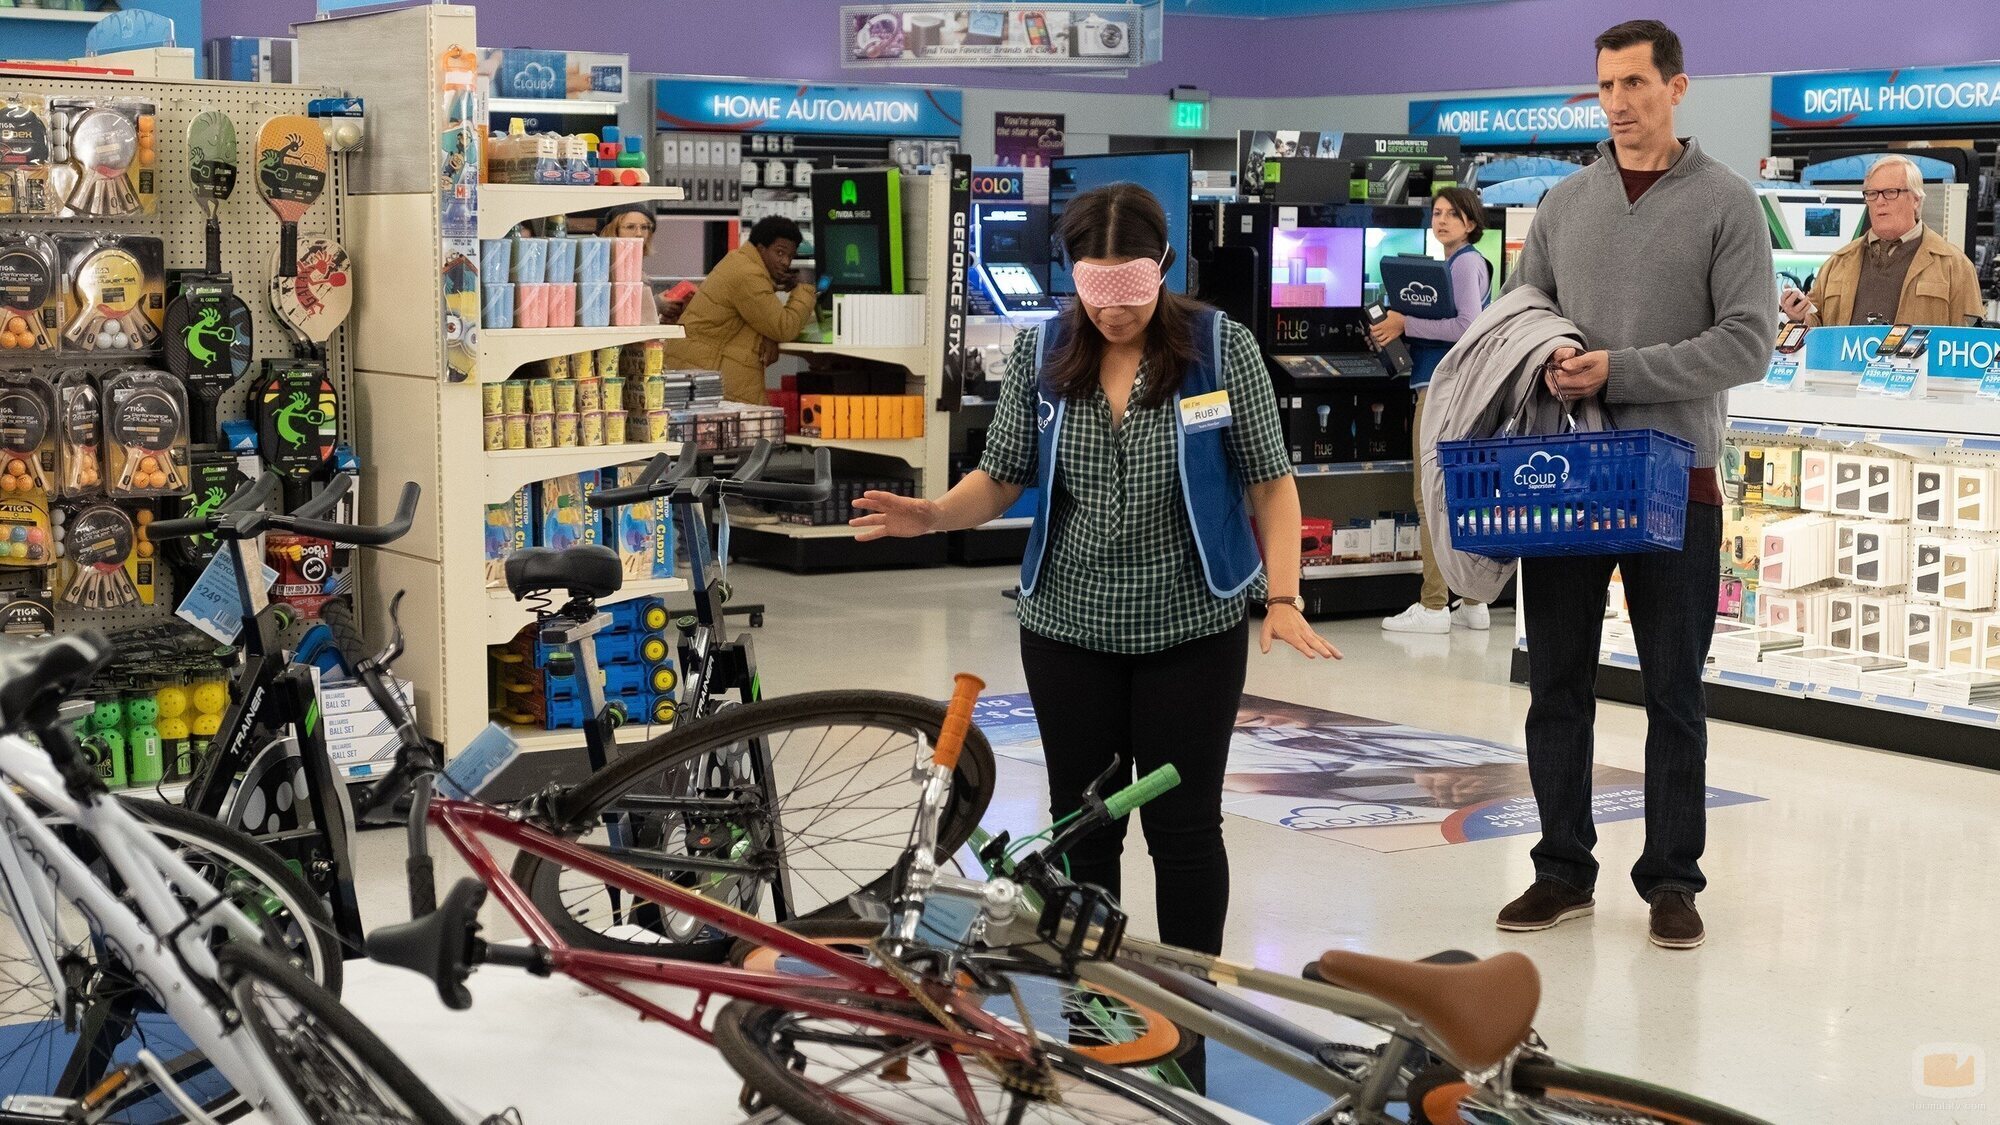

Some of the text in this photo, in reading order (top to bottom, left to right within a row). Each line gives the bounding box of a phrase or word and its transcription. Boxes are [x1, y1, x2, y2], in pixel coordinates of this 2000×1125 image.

[1804, 87, 1873, 114] DIGITAL
[713, 95, 919, 123] HOME AUTOMATION
[1176, 103, 1203, 128] EXIT
[1003, 116, 1057, 128] You're always
[1437, 110, 1489, 133] MOBILE
[996, 127, 1039, 137] the star at
[1375, 140, 1387, 153] 10
[1387, 145, 1428, 154] GEFORCE GTX
[972, 177, 1020, 196] COLOR
[948, 211, 967, 355] GEFORCE GTX
[1276, 313, 1310, 340] hue
[124, 405, 147, 413] STIGA
[1194, 408, 1219, 420] RUBY
[1314, 440, 1334, 456] hue
[1514, 472, 1569, 485] CLOUD 9
[656, 524, 666, 565] CADDY
[9, 608, 40, 617] STIGA
[325, 699, 351, 709] BALL SET
[229, 686, 267, 755] TRAINER
[329, 725, 355, 736] BALL SET
[332, 749, 357, 760] BALL SET
